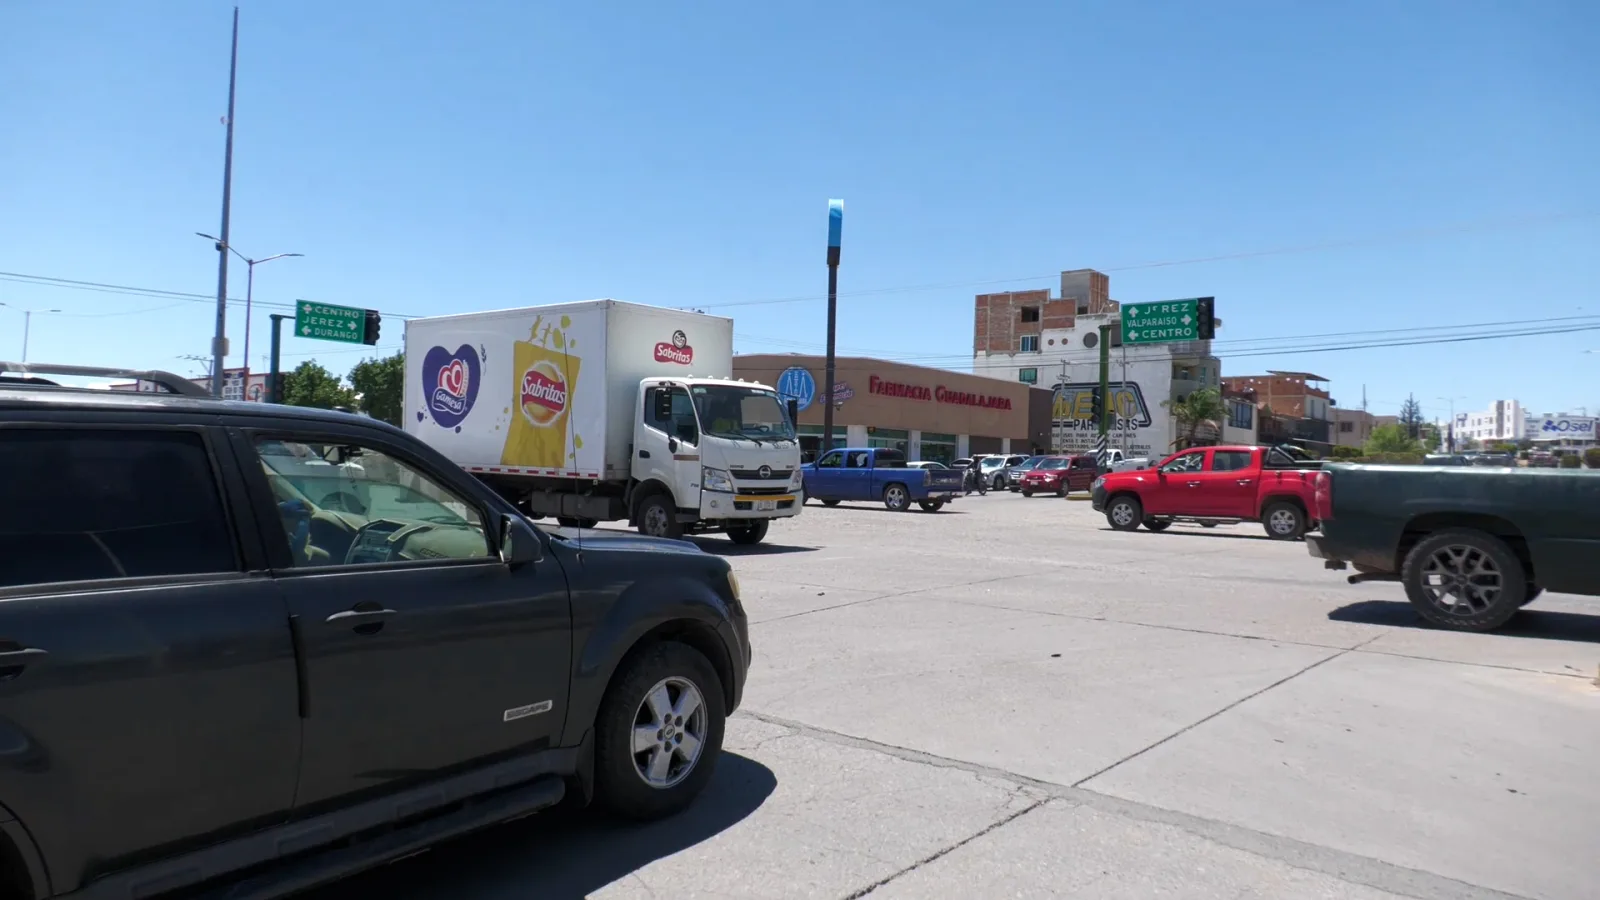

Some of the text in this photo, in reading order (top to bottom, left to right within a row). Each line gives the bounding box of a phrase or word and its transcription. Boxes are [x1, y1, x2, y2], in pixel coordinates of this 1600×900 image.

[314, 306, 359, 319] CENTRO
[302, 316, 344, 328] JEREZ
[1127, 317, 1177, 328] VALPARAISO
[314, 328, 358, 340] DURANGO
[1142, 328, 1192, 339] CENTRO
[656, 344, 691, 363] Sabritas
[521, 376, 566, 404] Sabritas
[436, 390, 462, 410] Gamesa
[1053, 391, 1138, 419] MEO
[1073, 419, 1138, 430] PARISAS
[1557, 420, 1593, 432] Osel
